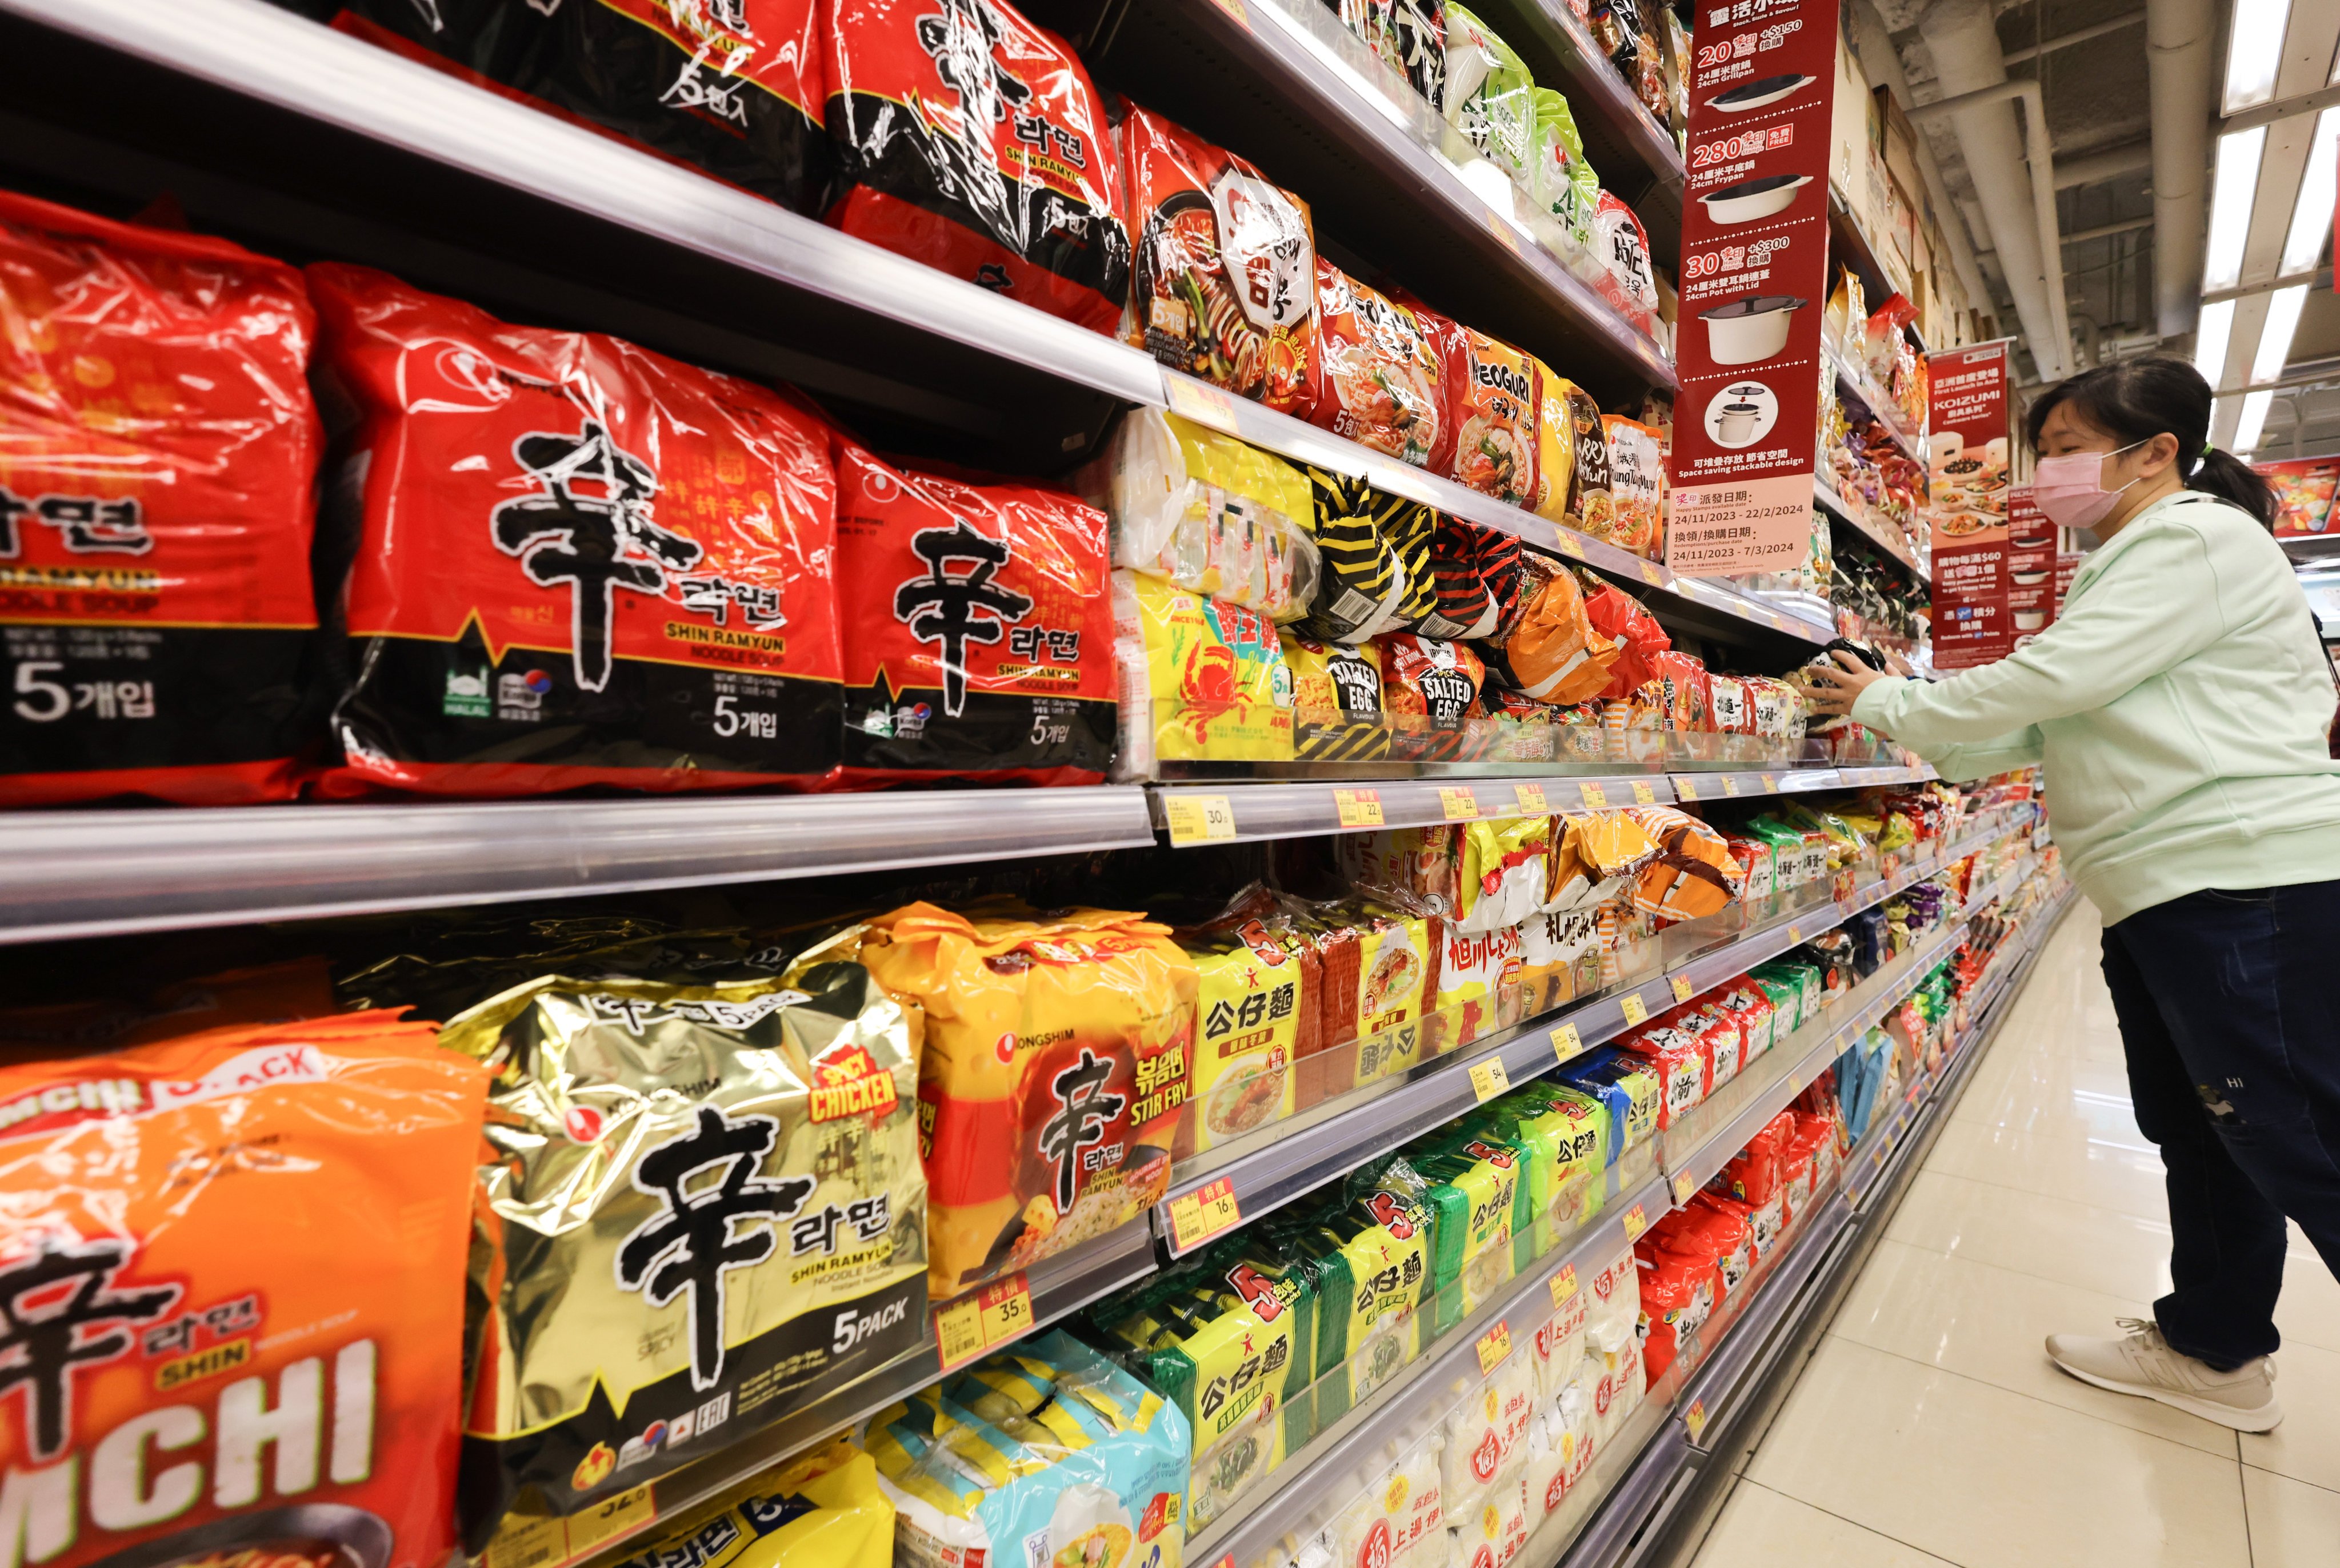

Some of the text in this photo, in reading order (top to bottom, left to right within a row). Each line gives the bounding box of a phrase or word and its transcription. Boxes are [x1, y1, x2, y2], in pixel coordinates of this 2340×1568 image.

[1733, 19, 1751, 27] Stack,
[1775, 5, 1799, 14] Savour!
[1761, 19, 1802, 38] +$150
[1698, 42, 1732, 68] 20
[1734, 49, 1755, 57] Stamps
[1759, 36, 1783, 51] 換購
[1697, 68, 1754, 89] 24cm Grillpan
[1698, 60, 1751, 82] 24厘米煎鍋
[1769, 137, 1789, 146] FREE
[1770, 128, 1790, 139] 免費
[1693, 137, 1743, 167] 280
[1742, 146, 1764, 155] Stamps
[1743, 142, 1763, 150] Happy
[1691, 159, 1755, 183] 24厘米平底鍋
[1691, 173, 1745, 190] 24cm Frypan
[1748, 237, 1790, 255] +$300
[1686, 252, 1718, 278] 30
[1747, 253, 1771, 267] 換購
[1685, 282, 1759, 301] 24cm Pot with Lid
[1686, 269, 1770, 293] 24厘米雙耳鍋連蓋
[1471, 351, 1530, 404] NEOGURI
[1951, 383, 1975, 392] Launch
[1934, 390, 2000, 410] KOIZUMI
[1678, 457, 1804, 478] Space saving stackable design
[1694, 449, 1788, 468] 可堆疊存放 節省空間
[1675, 505, 1803, 525] 24/11/2023 22/2/2024
[490, 415, 705, 693] 辛
[1673, 543, 1794, 561] 24/11/2023 7/3/2024
[1674, 540, 1730, 548] Redemptions/purchase
[679, 578, 787, 631] 라면
[893, 515, 1034, 718] 辛
[666, 622, 784, 653] SHIN RAMYUN
[1010, 625, 1080, 663] 라면
[691, 646, 743, 664] NOODLE
[1406, 650, 1422, 665] BOOM
[13, 661, 155, 722] 5개입
[1349, 686, 1372, 712] EGG
[1425, 677, 1471, 703] SALTED
[713, 695, 777, 738] 5개입
[1436, 699, 1461, 722] EGG
[1030, 715, 1070, 745] 5개입
[1207, 810, 1228, 824] 30.0
[1235, 919, 1287, 967] 5
[1205, 982, 1294, 1041] 公仔麵
[824, 1053, 865, 1083] SPICY
[1135, 1039, 1185, 1094] 볶음면
[1493, 1067, 1504, 1079] 54.5
[810, 1070, 896, 1119] CHICKEN
[2226, 1077, 2243, 1088] HI
[1130, 1081, 1188, 1127] STIR FRY
[1545, 1098, 1587, 1121] 5
[1039, 1046, 1126, 1215] 辛
[1084, 1142, 1124, 1171] 라면
[1463, 1140, 1513, 1169] 5
[1557, 1129, 1596, 1165] 公仔麵
[1091, 1168, 1115, 1185] SHIN
[1129, 1159, 1161, 1183] GOURMET
[1081, 1176, 1124, 1198] RAMYUN
[1204, 1180, 1227, 1201] 特價
[1216, 1198, 1234, 1215] 16.0
[1364, 1191, 1415, 1241] 5
[1473, 1177, 1514, 1233] 公仔麵
[790, 1191, 890, 1256] 라면
[614, 1102, 818, 1392] 辛
[791, 1241, 893, 1285] SHIN RAMYUN
[813, 1265, 863, 1288] NOODLE
[831, 1279, 862, 1293] Instant
[1357, 1250, 1422, 1314] 公仔麵
[988, 1276, 1019, 1304] 特價
[1225, 1262, 1286, 1326] 5
[999, 1298, 1027, 1322] 35.0
[142, 1294, 259, 1358] 라면
[832, 1297, 910, 1354] 5PACK
[1492, 1325, 1505, 1339] 特價
[1499, 1337, 1510, 1349] 16.0
[158, 1342, 249, 1386] SHIN
[1201, 1333, 1287, 1421] 公仔麵
[1475, 1434, 1495, 1475] 福
[1367, 1525, 1387, 1568] 福
